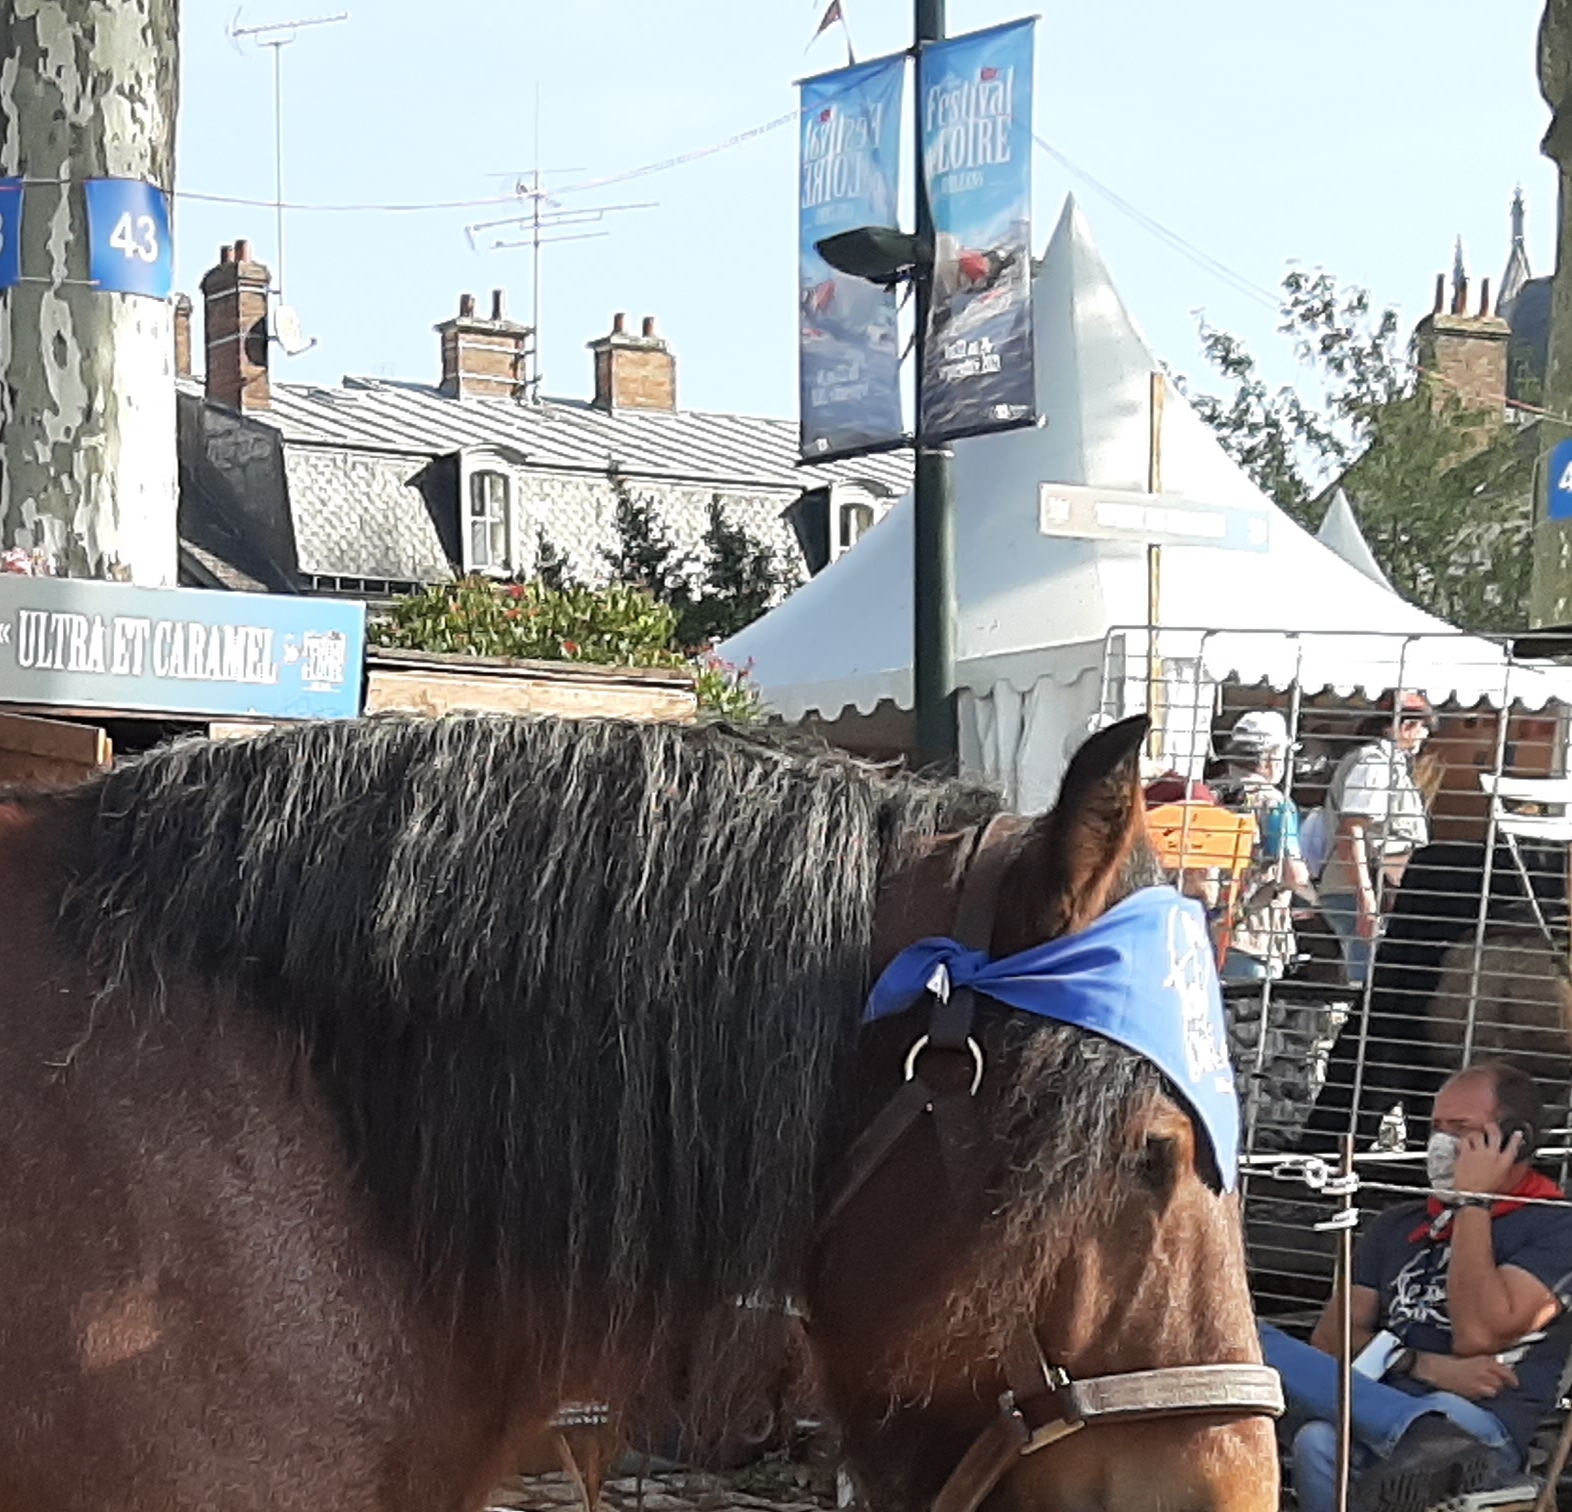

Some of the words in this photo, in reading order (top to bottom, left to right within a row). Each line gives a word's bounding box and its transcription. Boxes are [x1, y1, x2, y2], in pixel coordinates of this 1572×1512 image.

[109, 211, 160, 263] 43
[18, 609, 105, 673] ULTRA
[111, 616, 150, 676] ET
[153, 620, 278, 684] CARAMEL
